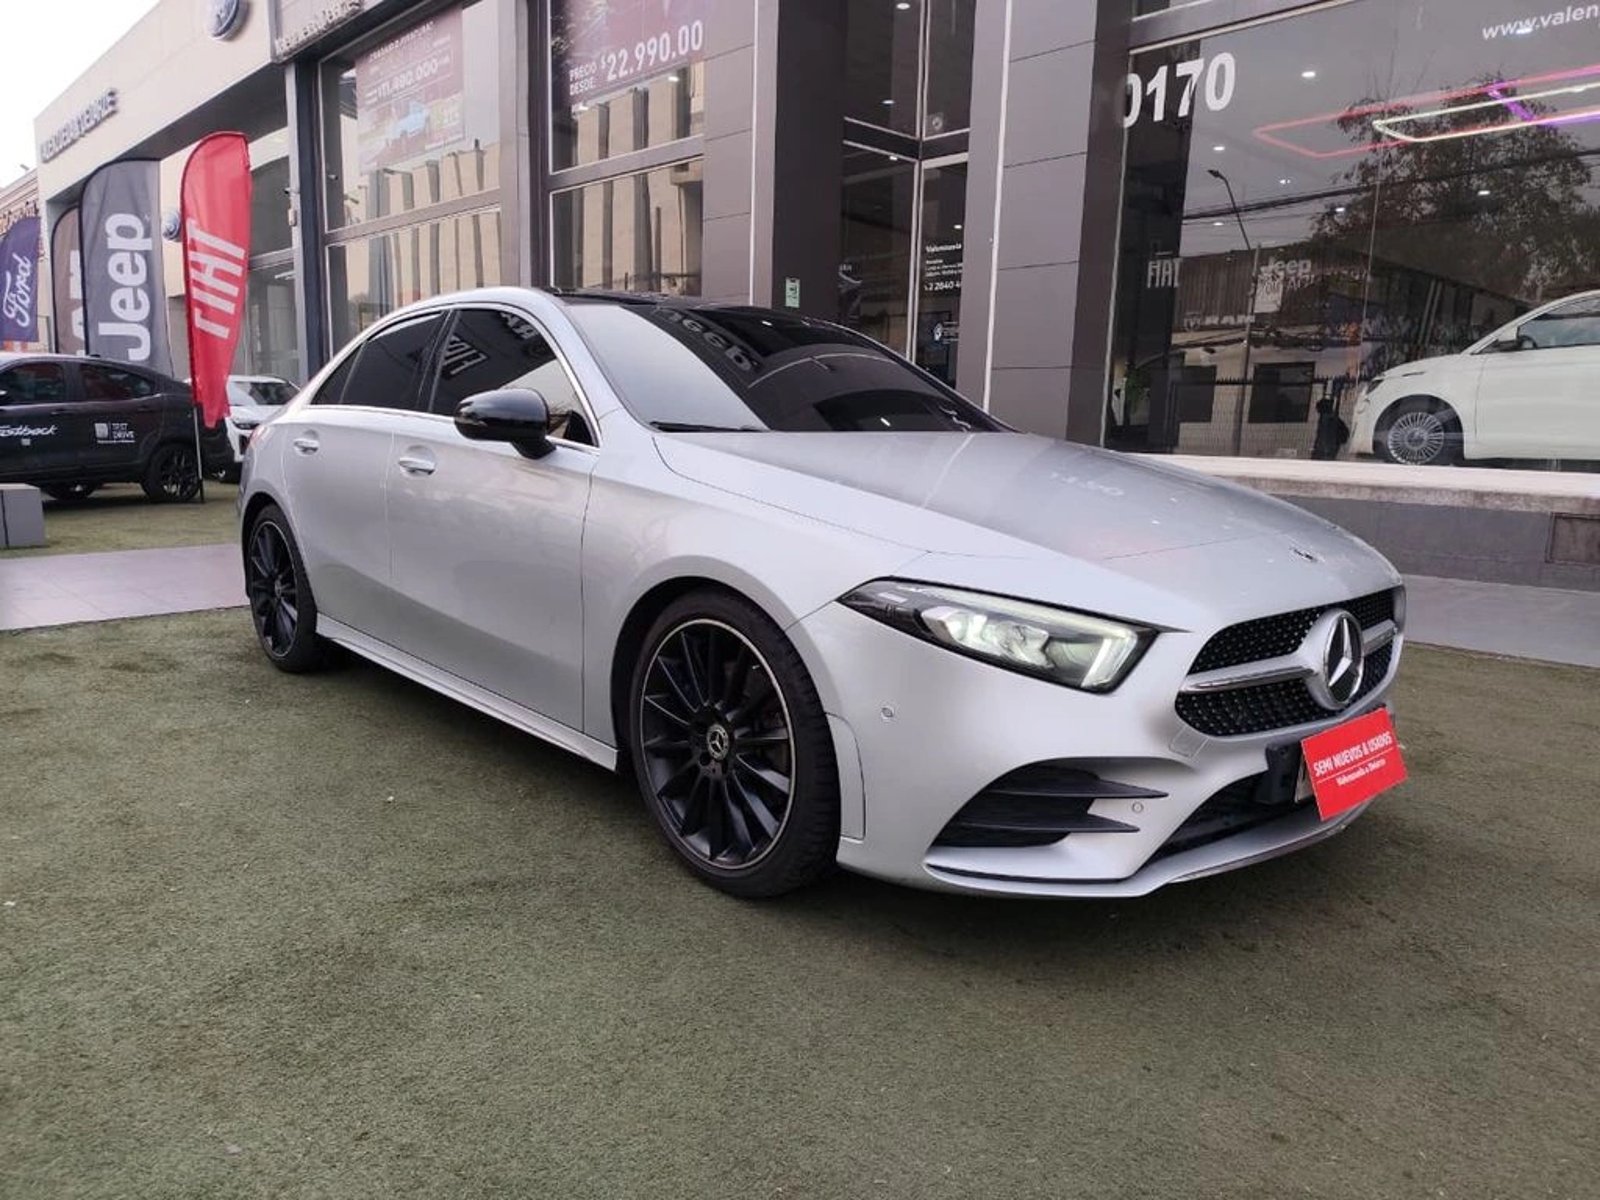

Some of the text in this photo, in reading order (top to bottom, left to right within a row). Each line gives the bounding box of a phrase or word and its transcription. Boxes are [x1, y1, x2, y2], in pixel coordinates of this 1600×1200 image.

[3, 252, 32, 327] Ford
[98, 212, 153, 362] Jeep
[185, 216, 247, 339] FIAT
